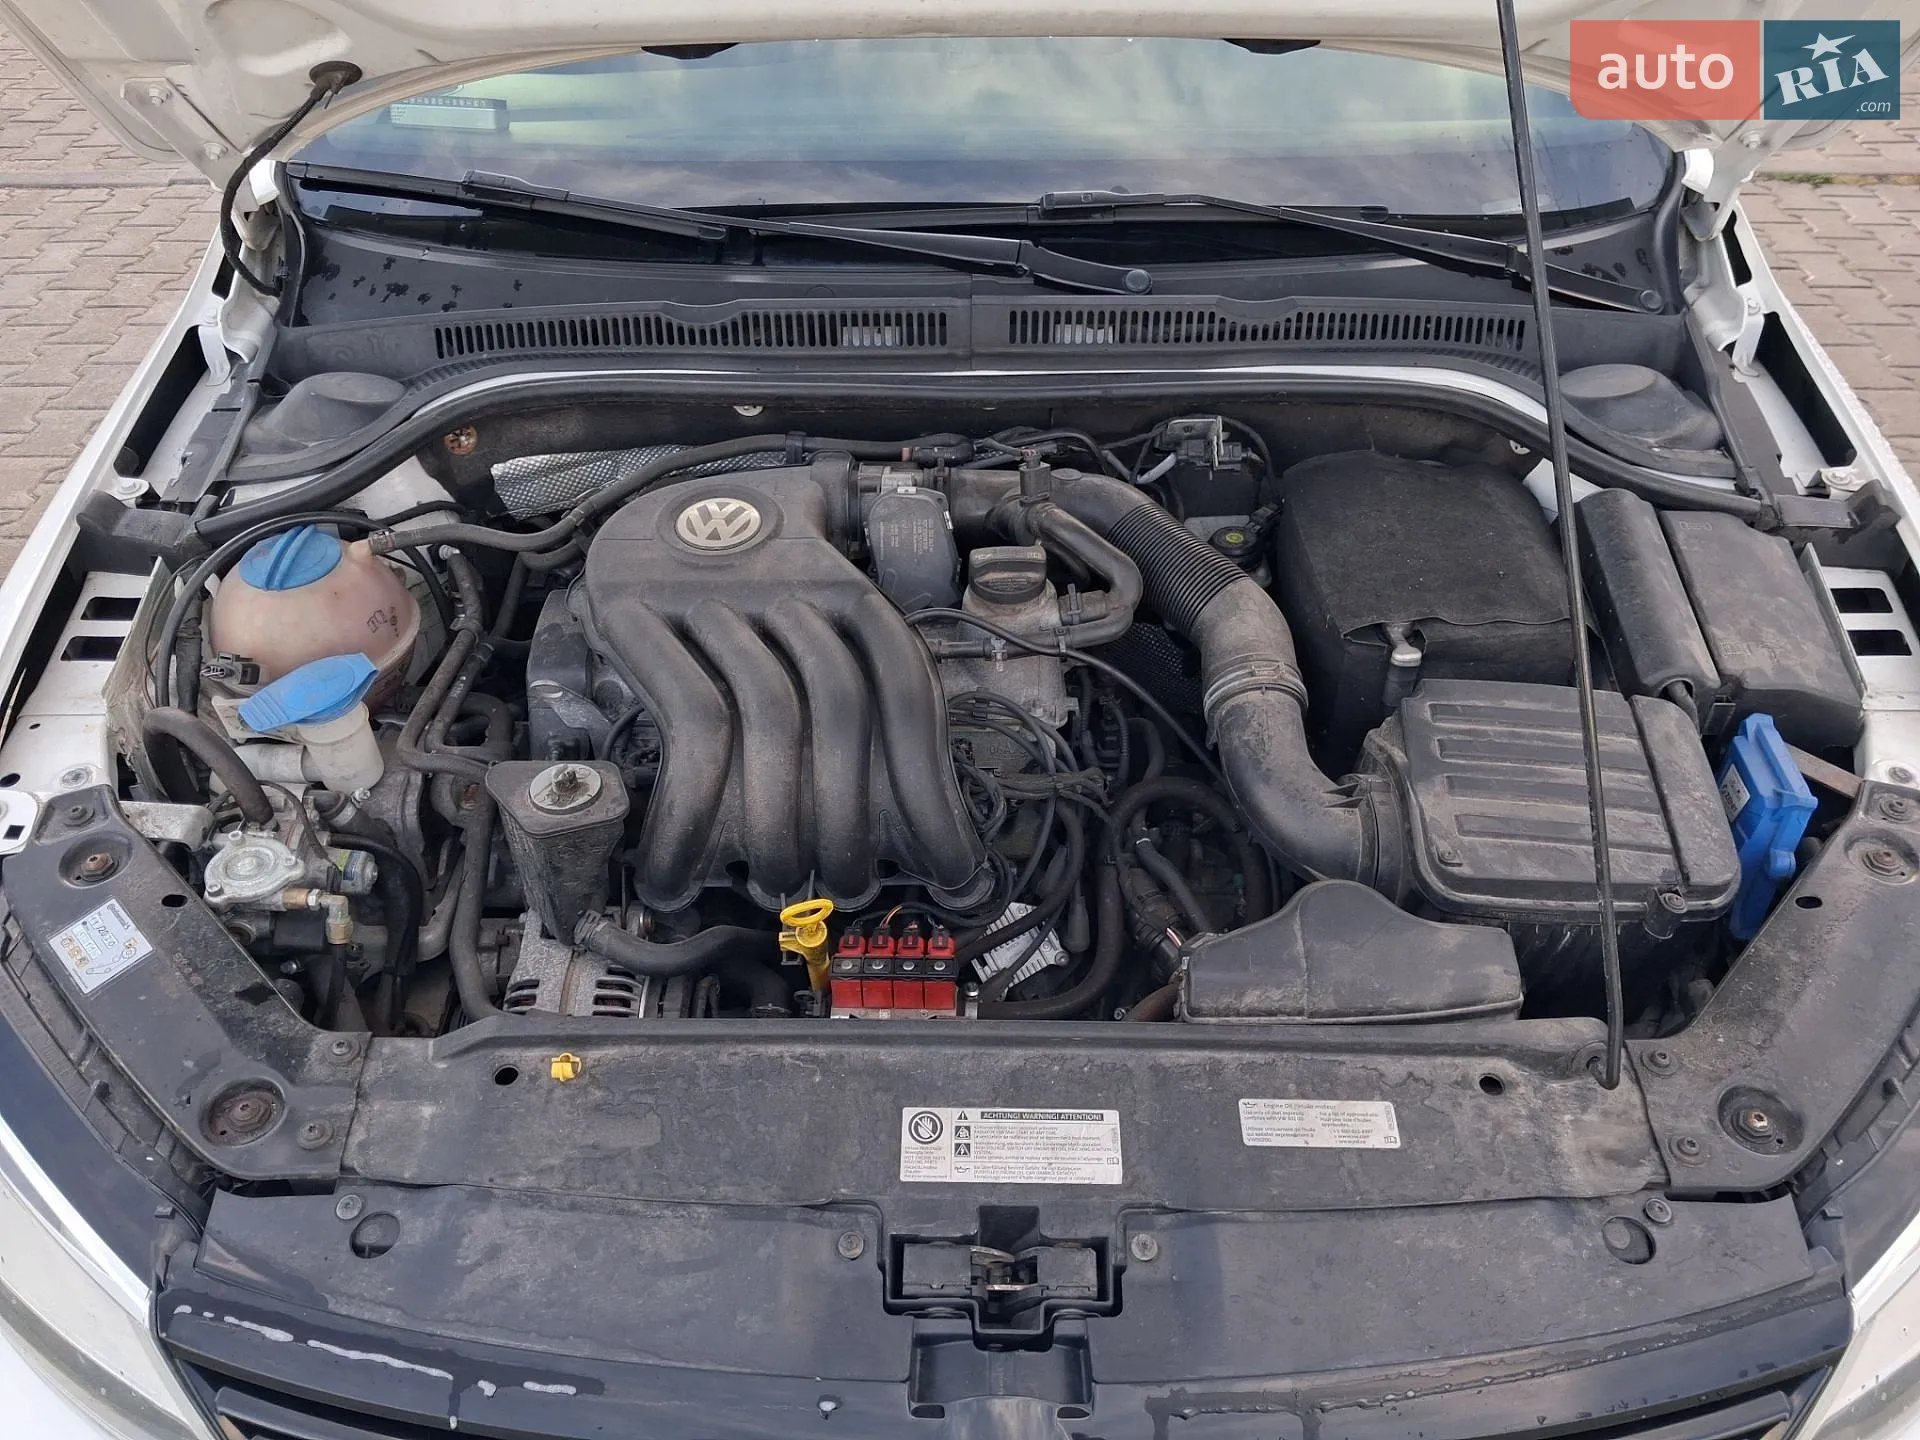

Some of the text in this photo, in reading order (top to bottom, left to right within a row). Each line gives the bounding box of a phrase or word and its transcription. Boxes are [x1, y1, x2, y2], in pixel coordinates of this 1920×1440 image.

[983, 1112, 1102, 1121] ACHTUNG! WARNING! ATTENTION!
